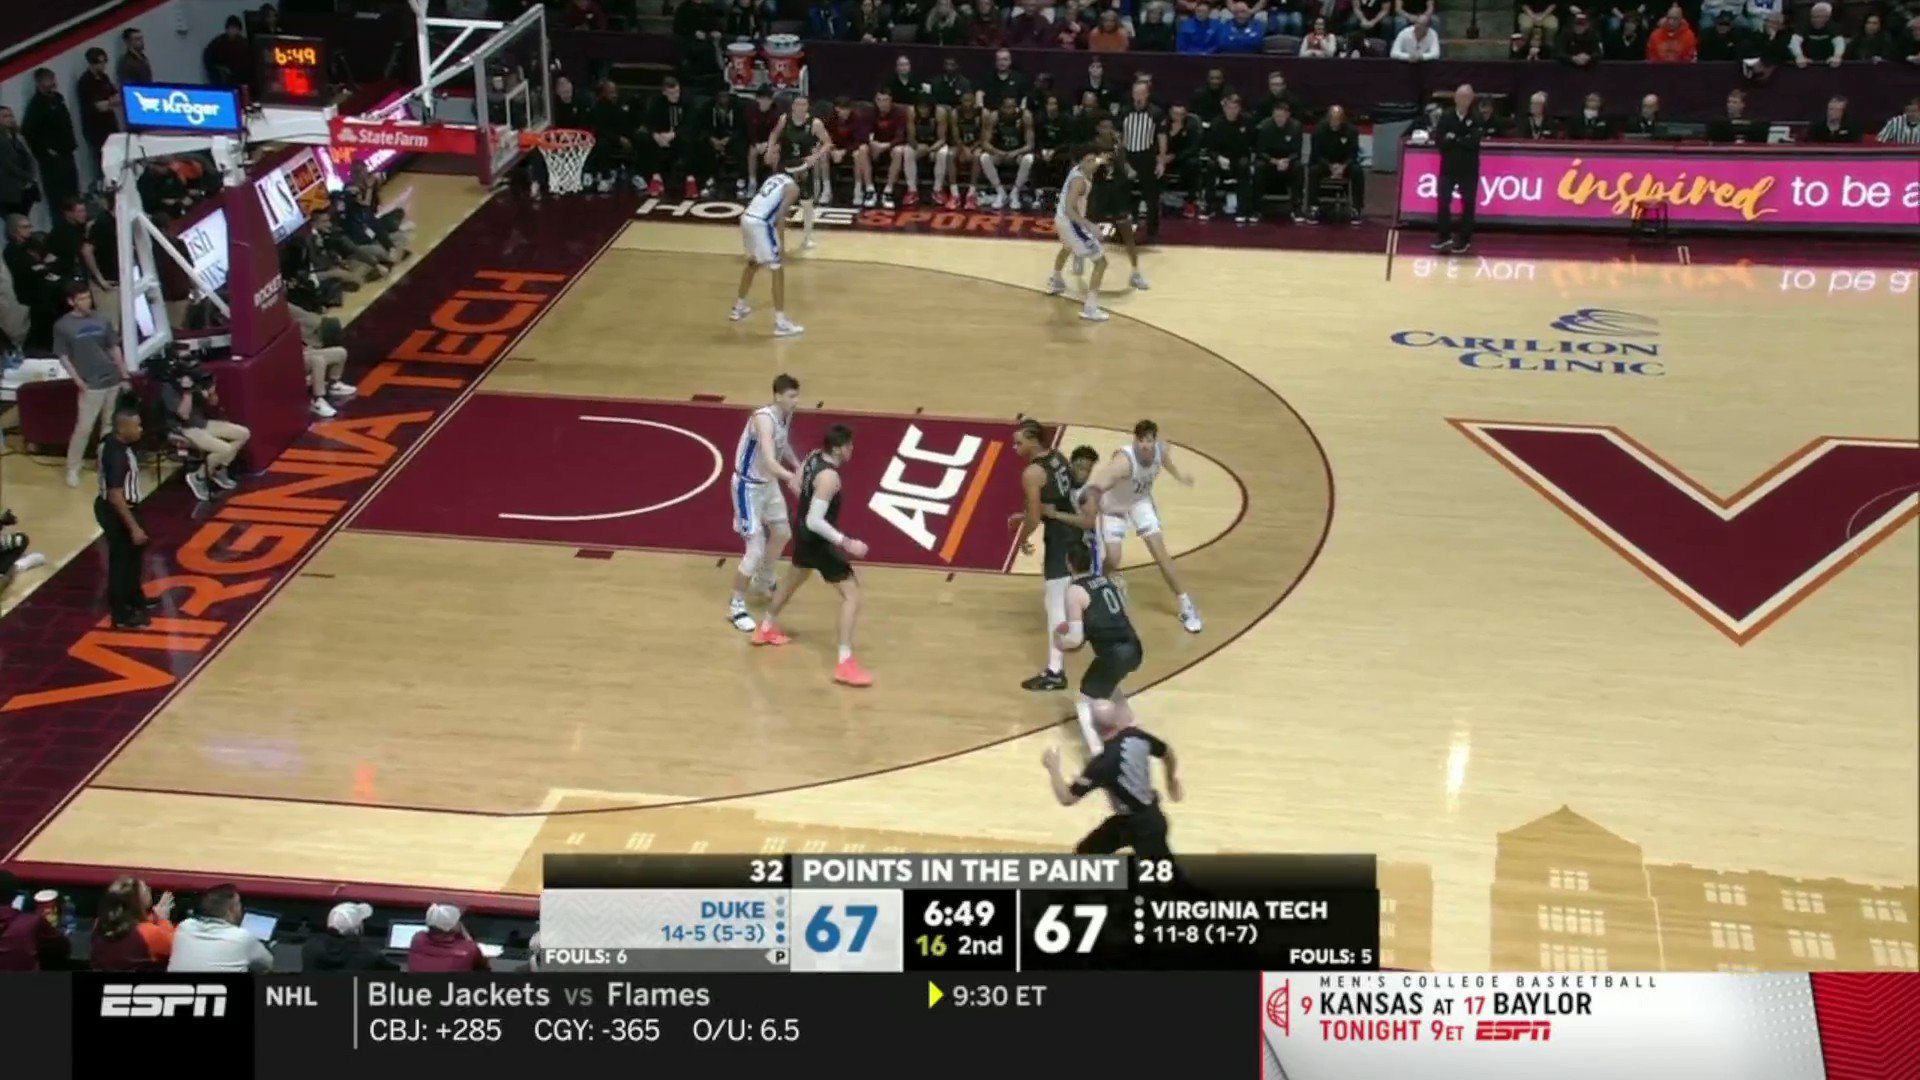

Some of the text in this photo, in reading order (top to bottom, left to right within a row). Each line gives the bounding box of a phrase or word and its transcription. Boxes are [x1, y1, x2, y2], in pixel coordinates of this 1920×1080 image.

[275, 47, 316, 65] 6:49
[163, 92, 219, 124] Kroger
[1480, 175, 1542, 206] you
[1557, 158, 1779, 220] inspired
[1791, 176, 1829, 207] to
[1842, 175, 1890, 207] be
[636, 198, 860, 225] HOIE
[1390, 330, 1660, 356] CARILION
[1458, 351, 1666, 376] CLINIC
[0, 269, 567, 712] VIRGINIA TECH
[869, 423, 983, 552] ACC
[1102, 587, 1121, 614] 0
